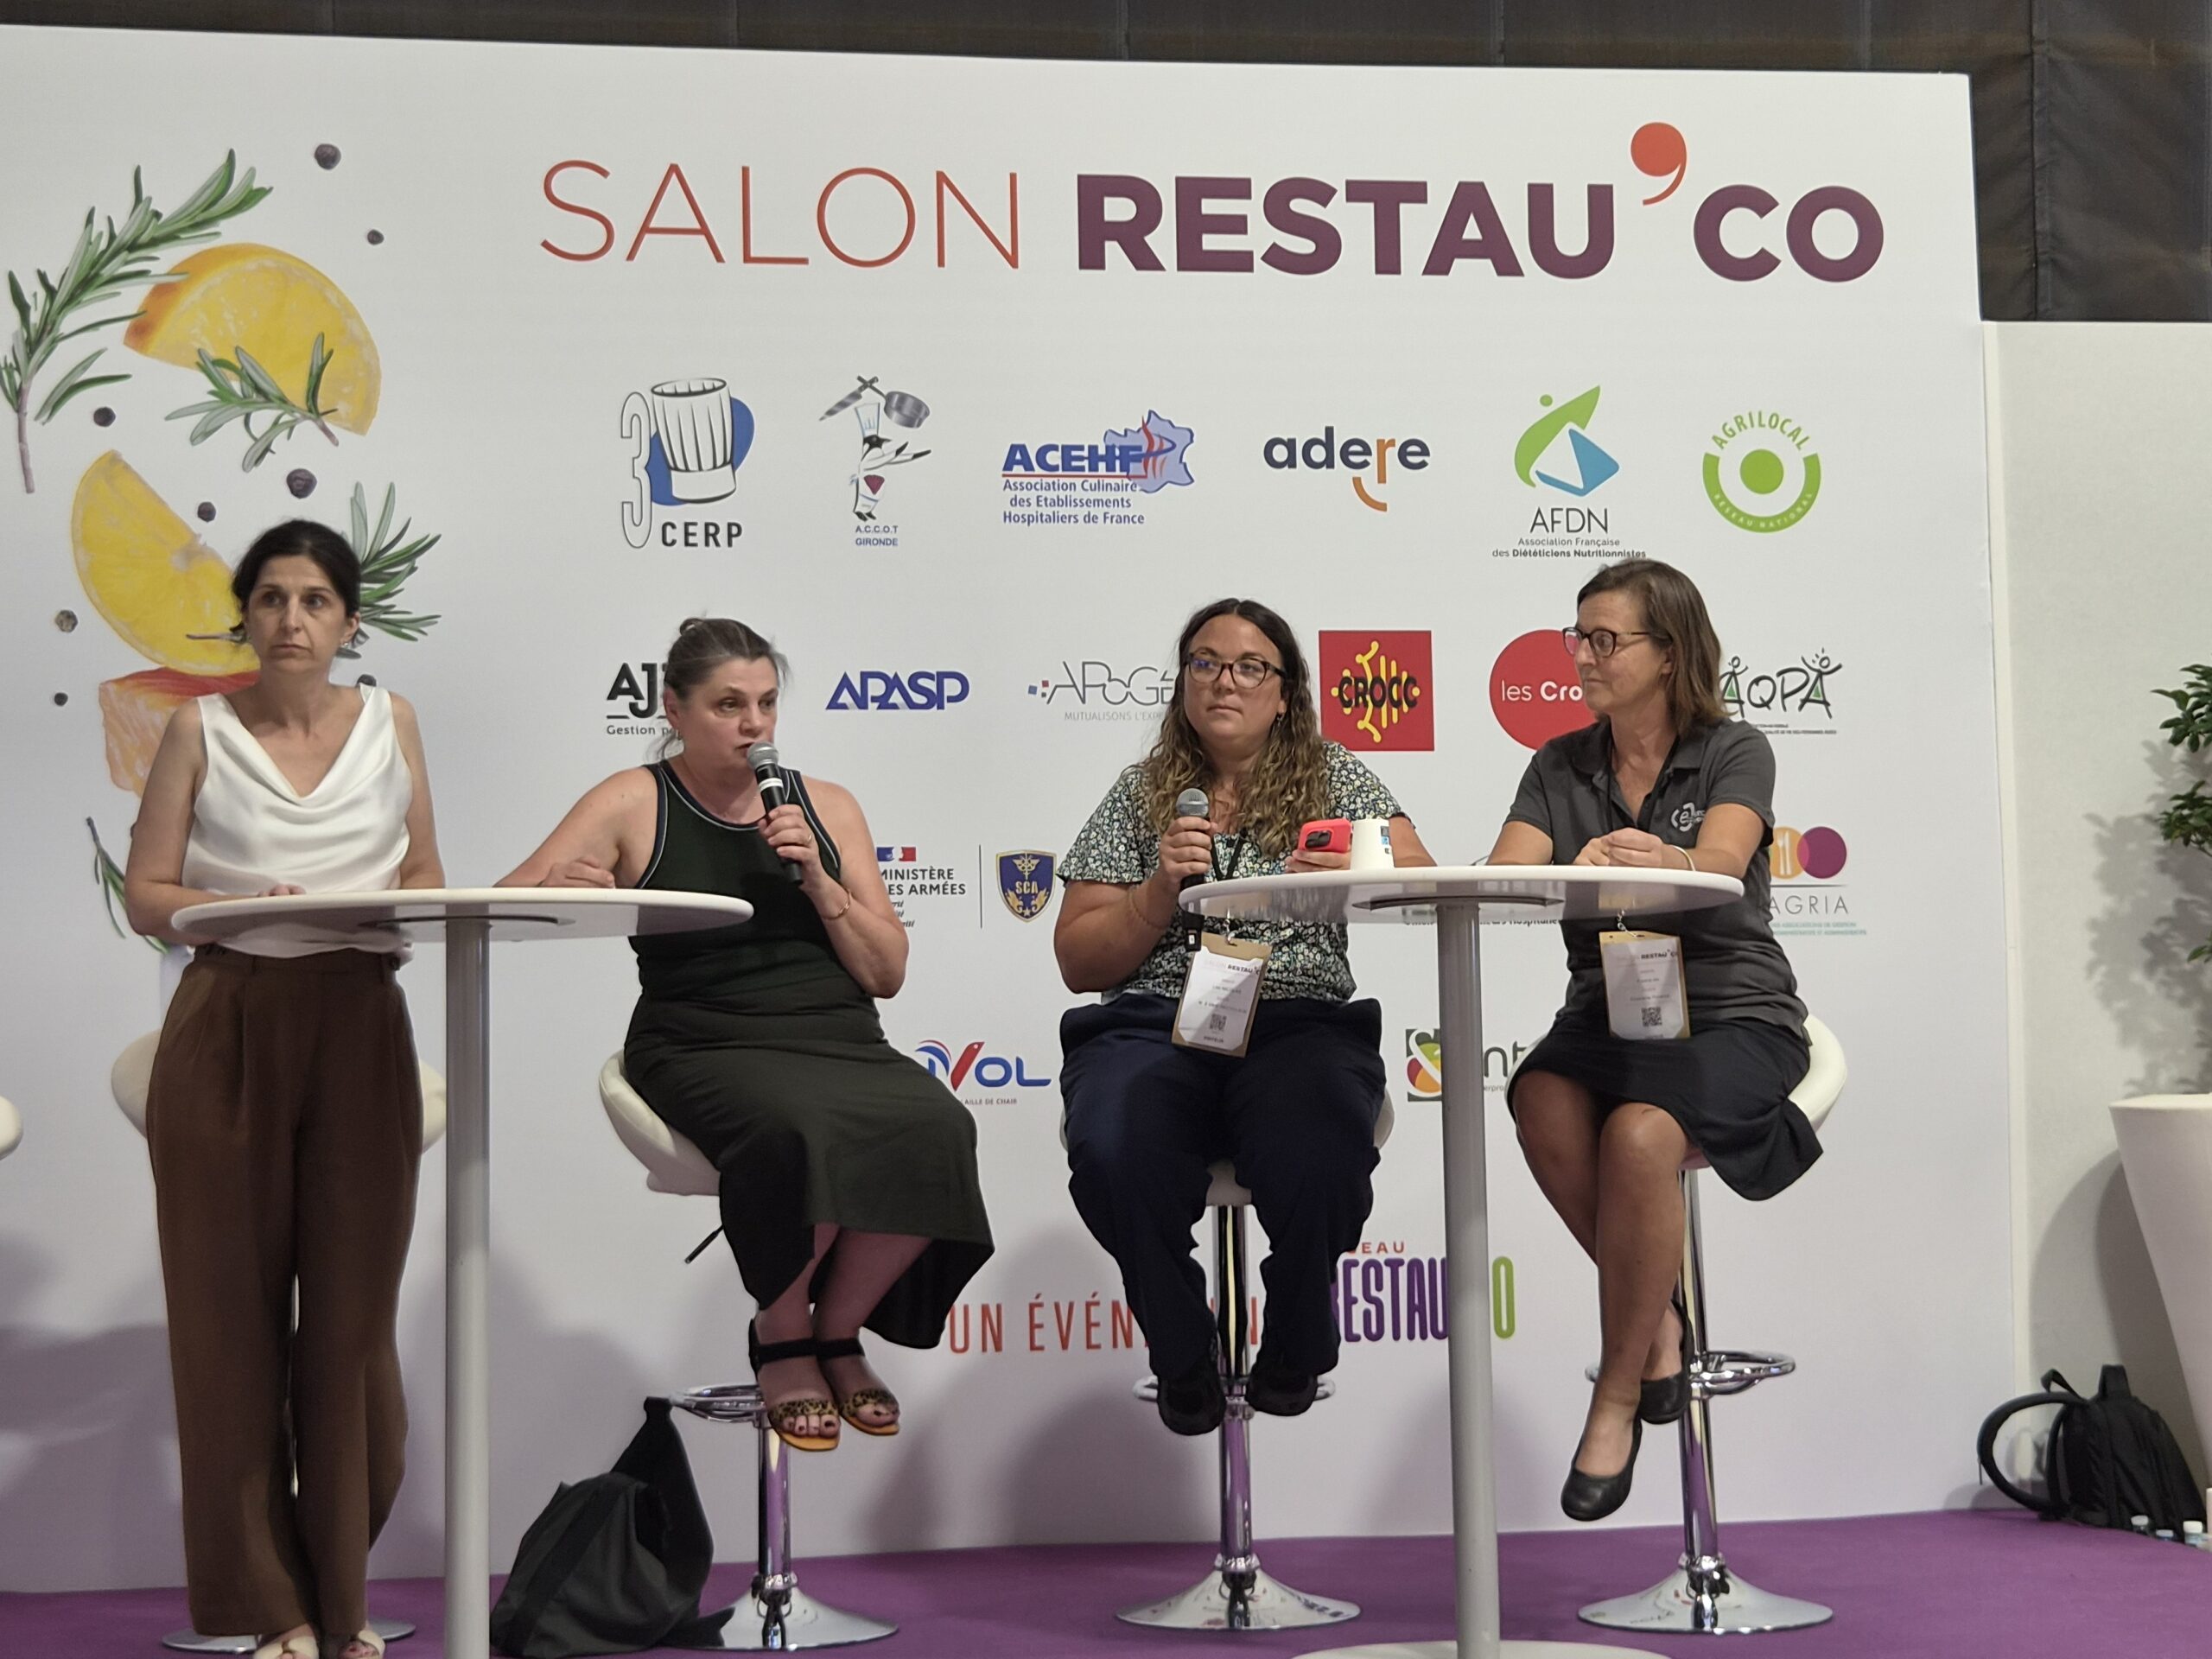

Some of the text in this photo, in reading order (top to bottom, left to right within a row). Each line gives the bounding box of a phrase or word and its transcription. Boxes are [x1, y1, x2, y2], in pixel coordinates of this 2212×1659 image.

[541, 160, 1019, 270] SALON
[1712, 410, 1810, 451] AGRILOCAL
[1002, 442, 1143, 473] ACEHF
[1263, 426, 1431, 484] adere
[1003, 479, 1137, 493] Association Culinaire
[1009, 495, 1131, 508] des Etablissements
[1003, 511, 1145, 526] Hospitaliers de France
[1529, 506, 1609, 533] AFDN
[661, 521, 743, 548] CERP
[855, 537, 899, 547] GIRONDE
[1518, 537, 1620, 548] Association Française
[1512, 549, 1571, 557] Diététiciens
[1573, 549, 1646, 557] Nutritionnistes
[607, 662, 667, 719] AJ
[1339, 676, 1417, 709] CROCC
[1501, 679, 1583, 702] les Cro
[1065, 711, 1132, 721] MUTUALISONS
[607, 724, 656, 735] Gestion
[887, 881, 966, 895] ES ARMÉES
[1015, 881, 1038, 894] SCA
[1770, 895, 1849, 914] AGRIA
[1349, 1242, 1404, 1254] EAU
[950, 1292, 1149, 1354] UN ÉVÉN
